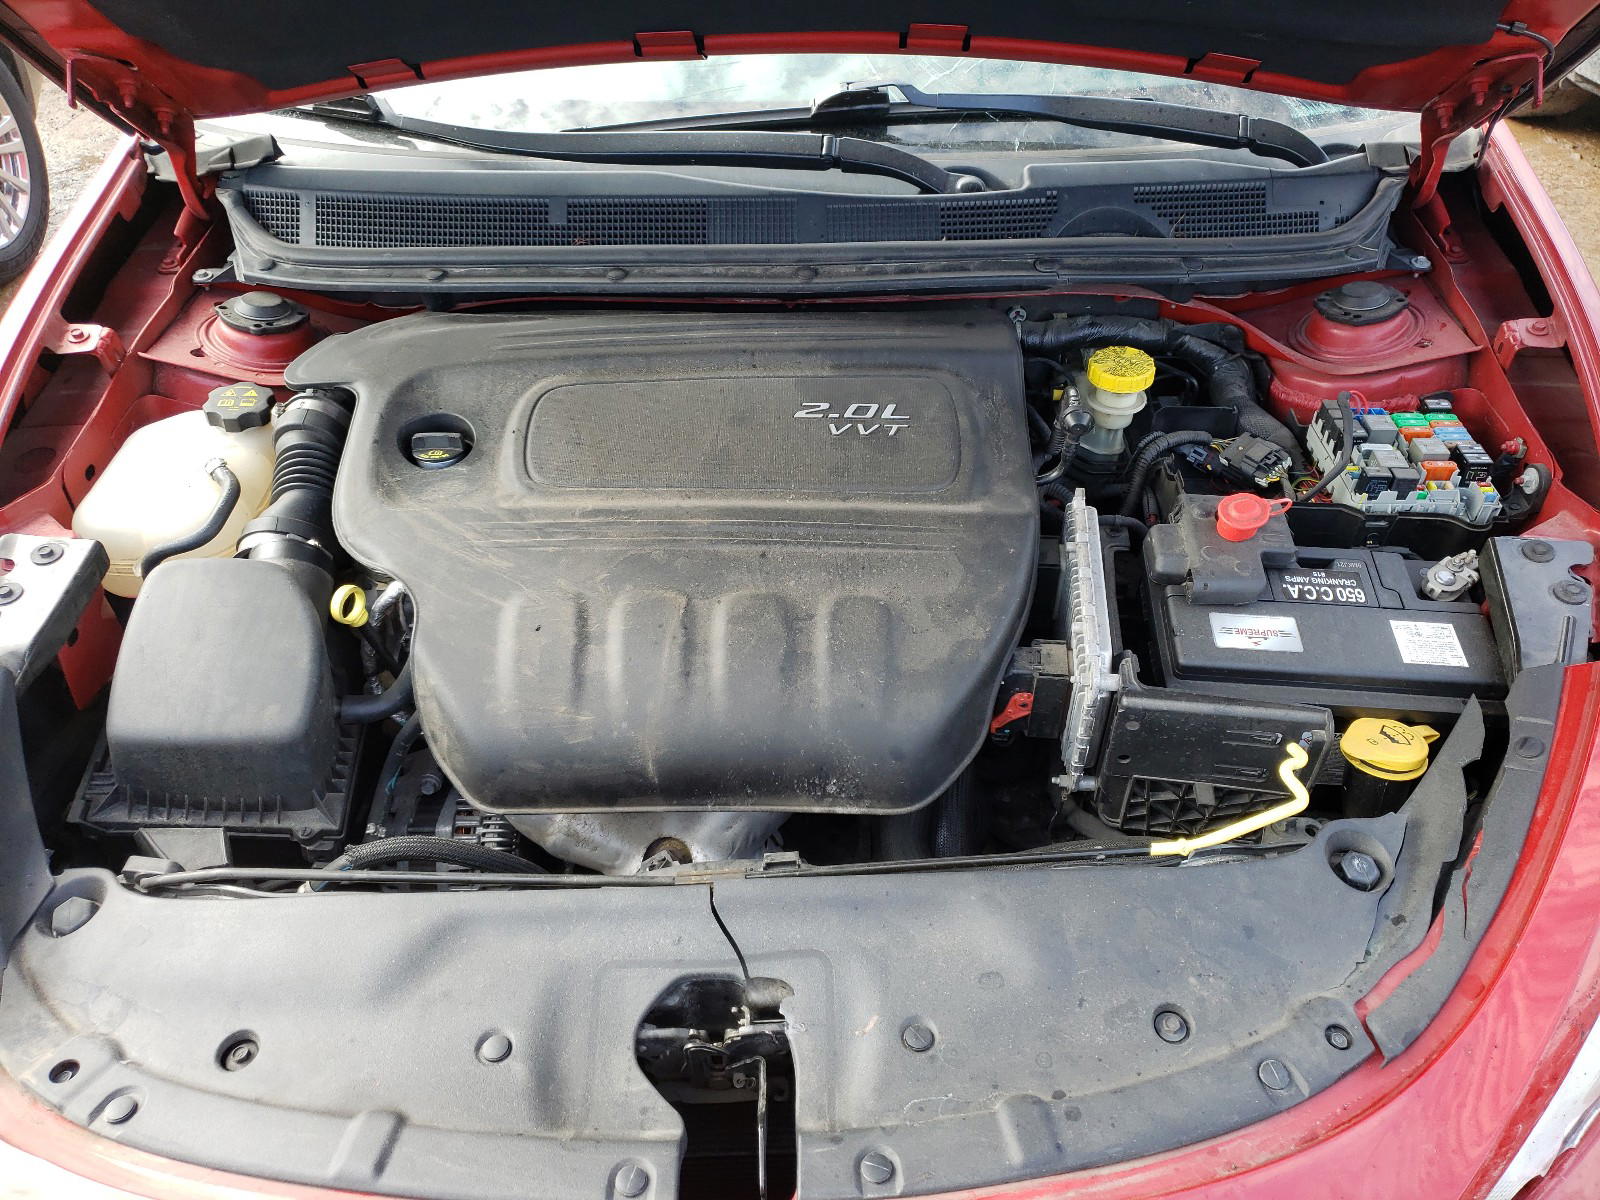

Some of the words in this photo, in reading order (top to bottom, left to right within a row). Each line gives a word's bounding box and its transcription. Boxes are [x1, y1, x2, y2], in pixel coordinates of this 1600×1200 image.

[793, 402, 910, 419] 2.0L
[828, 423, 910, 436] VVT
[1285, 575, 1310, 583] AMPS
[1311, 577, 1356, 586] CRANKING
[1336, 588, 1365, 602] 650
[1233, 627, 1279, 638] SUPREME
